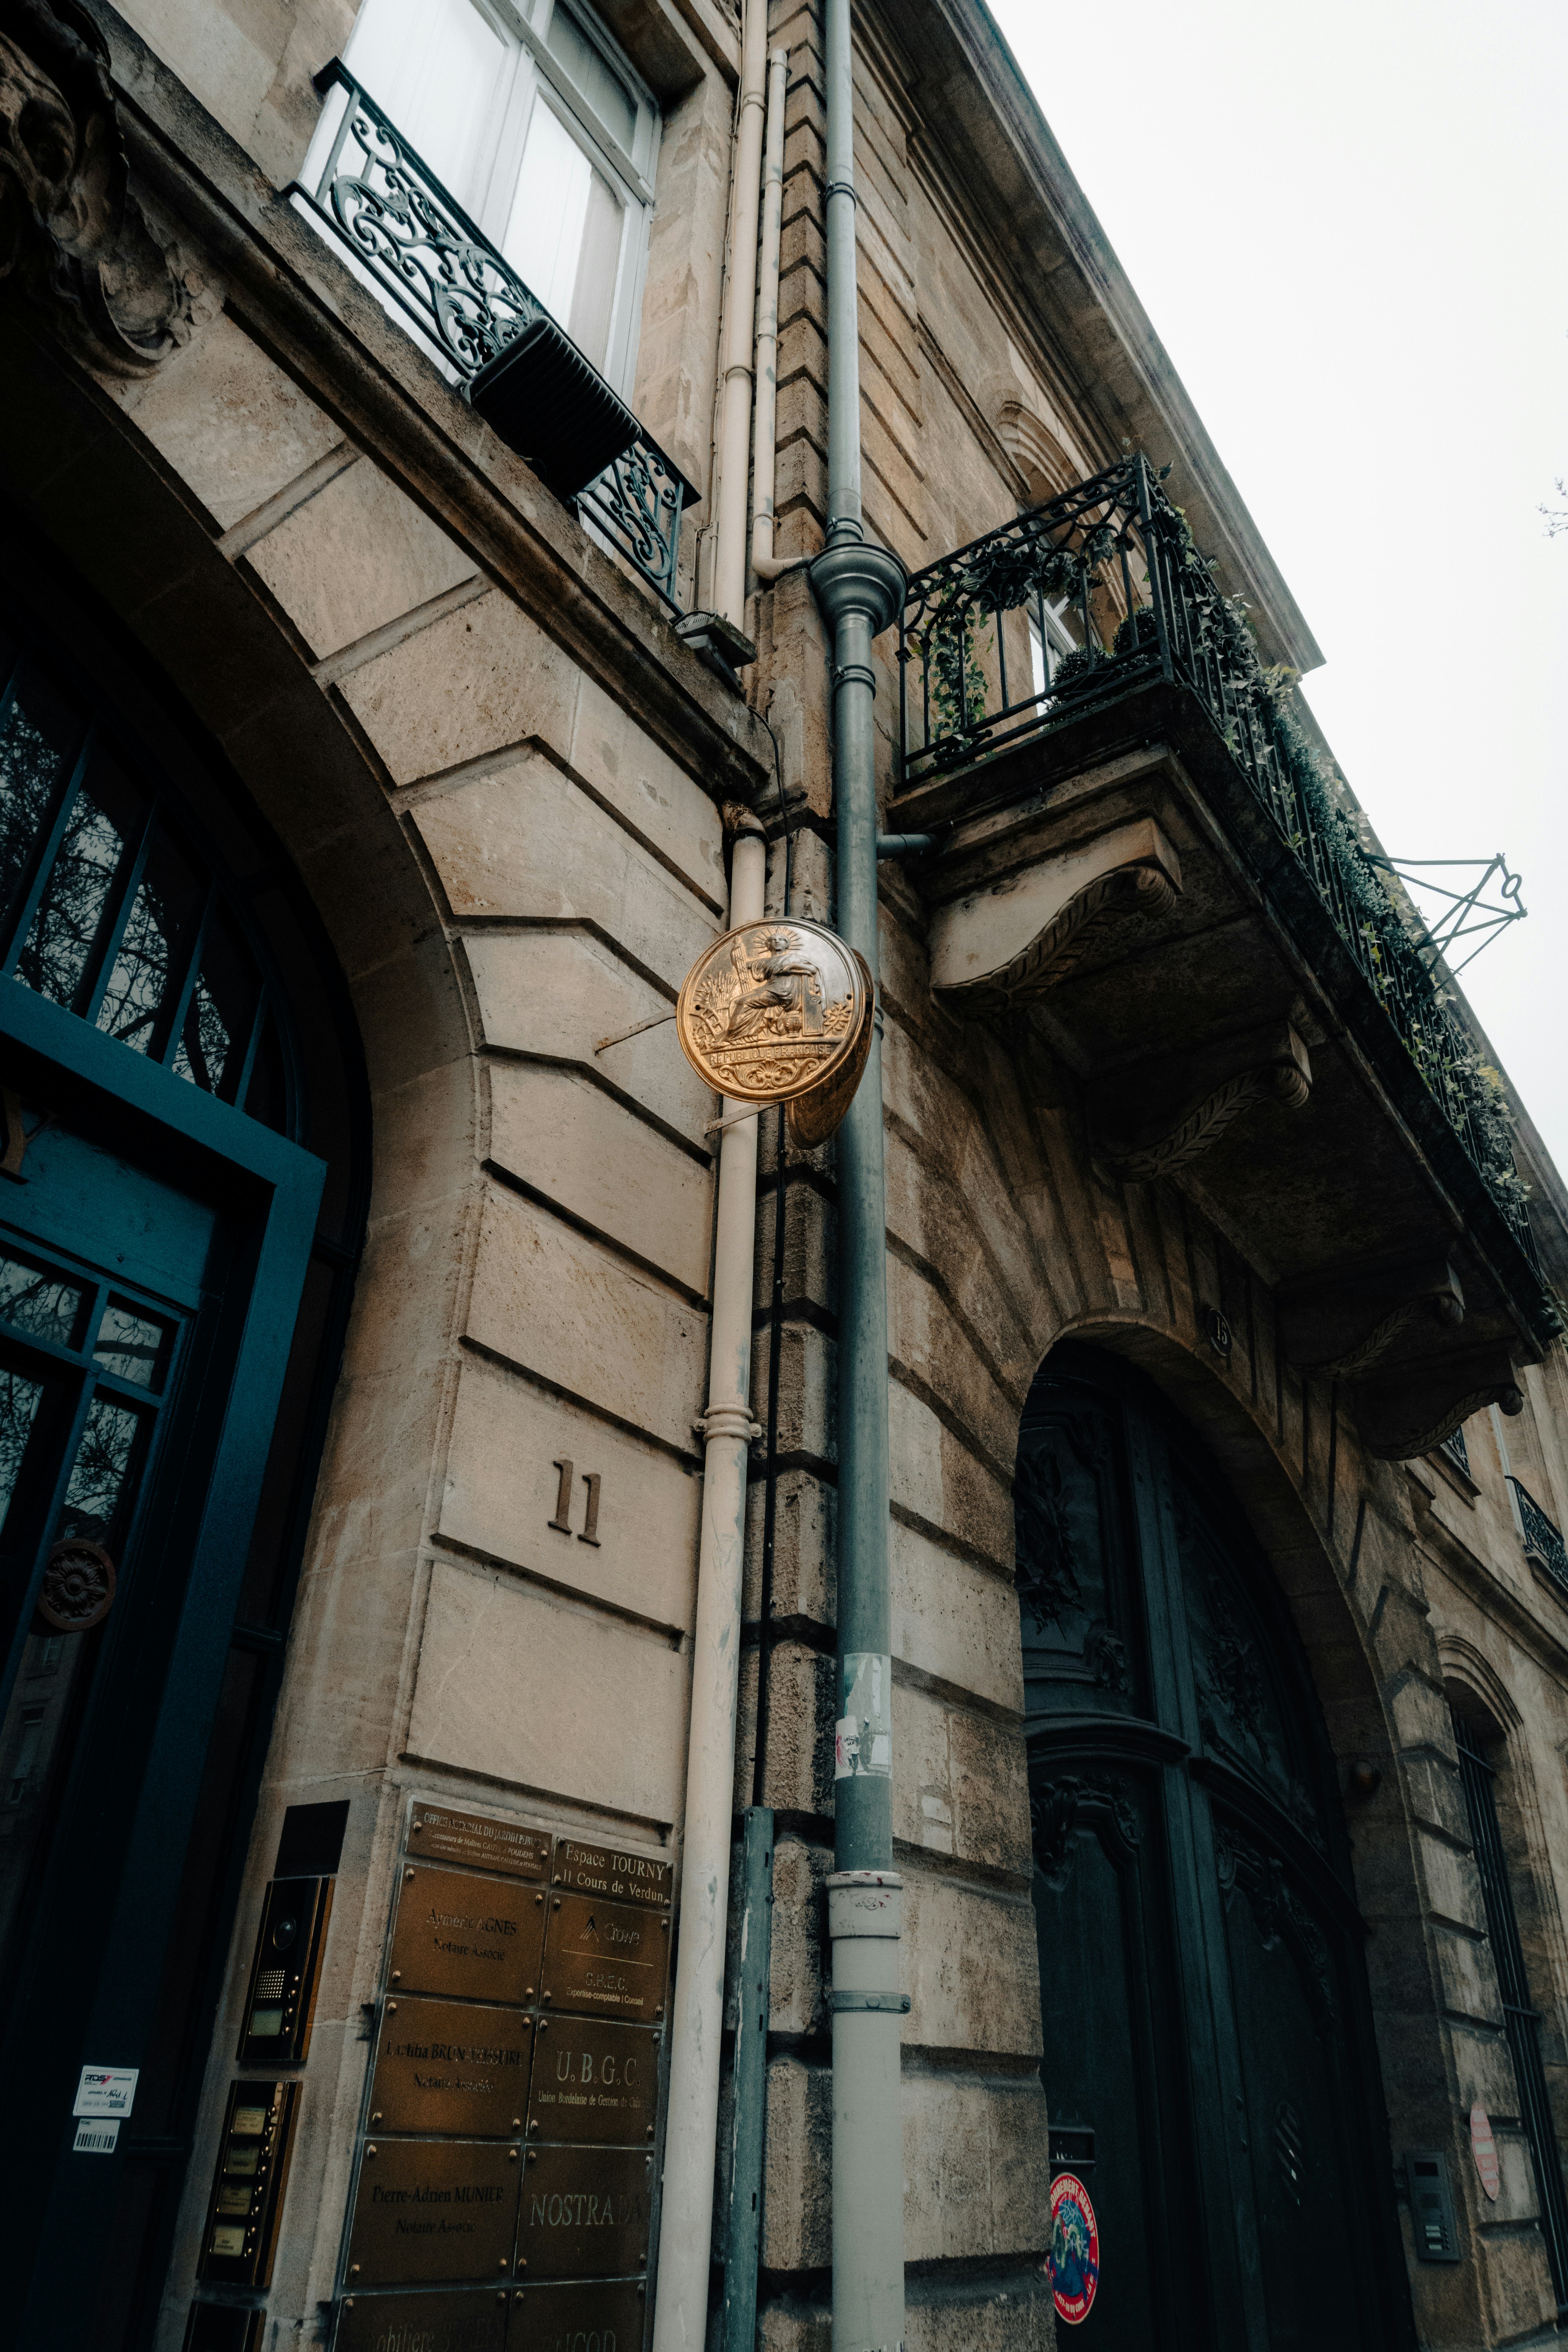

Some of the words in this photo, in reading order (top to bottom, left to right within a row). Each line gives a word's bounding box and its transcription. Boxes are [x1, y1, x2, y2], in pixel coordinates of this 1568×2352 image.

[1216, 1316, 1227, 1345] 15
[548, 1461, 601, 1549] 11
[424, 1812, 448, 1828] OFFICE
[483, 1826, 494, 1837] DU
[494, 1829, 519, 1844] JARDIN
[507, 1847, 534, 1860] POUDENS
[566, 1843, 605, 1867] Espace
[611, 1854, 665, 1881] TOURNY
[577, 1872, 607, 1891] Cours
[612, 1880, 624, 1894] de
[629, 1883, 663, 1902] Verdun
[426, 1908, 474, 1929] Aymeric
[476, 1918, 517, 1936] AGNES
[604, 1922, 640, 1945] Crowe
[433, 1938, 469, 1955] Notaire
[566, 1987, 620, 2003] Expertise-comptable
[624, 1995, 644, 2005] Conseil
[556, 2050, 641, 2086] U.B.G.C.
[413, 2073, 450, 2090] Notaire
[538, 2090, 556, 2103] Union
[558, 2091, 588, 2105] Bordelaise
[589, 2094, 597, 2106] de
[598, 2094, 619, 2107] Gestion
[372, 2185, 451, 2203] Pierre-Adrien
[454, 2186, 504, 2203] MUNIER
[396, 2219, 435, 2234] Notaire
